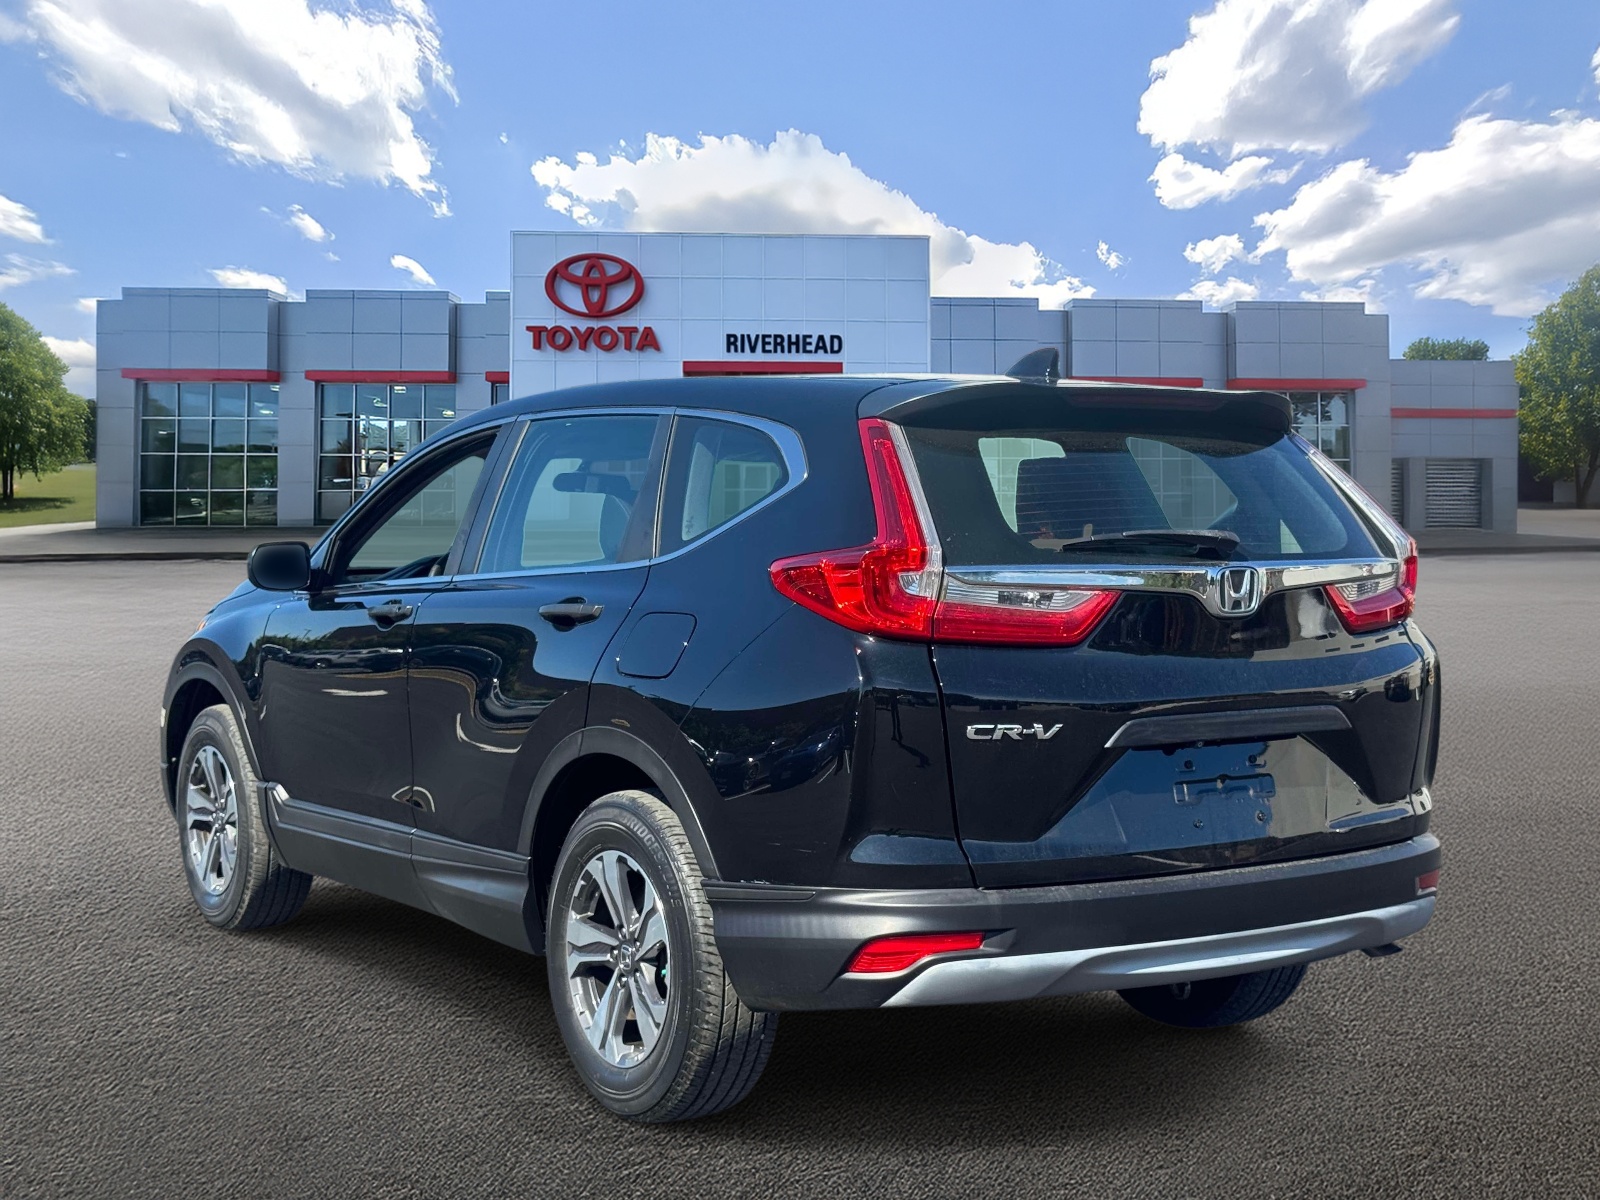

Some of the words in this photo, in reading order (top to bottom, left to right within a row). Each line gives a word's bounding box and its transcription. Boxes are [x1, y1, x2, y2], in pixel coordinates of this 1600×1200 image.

[526, 326, 661, 351] TOYOTA
[726, 334, 843, 354] RIVERHEAD
[966, 723, 1064, 740] CR-V
